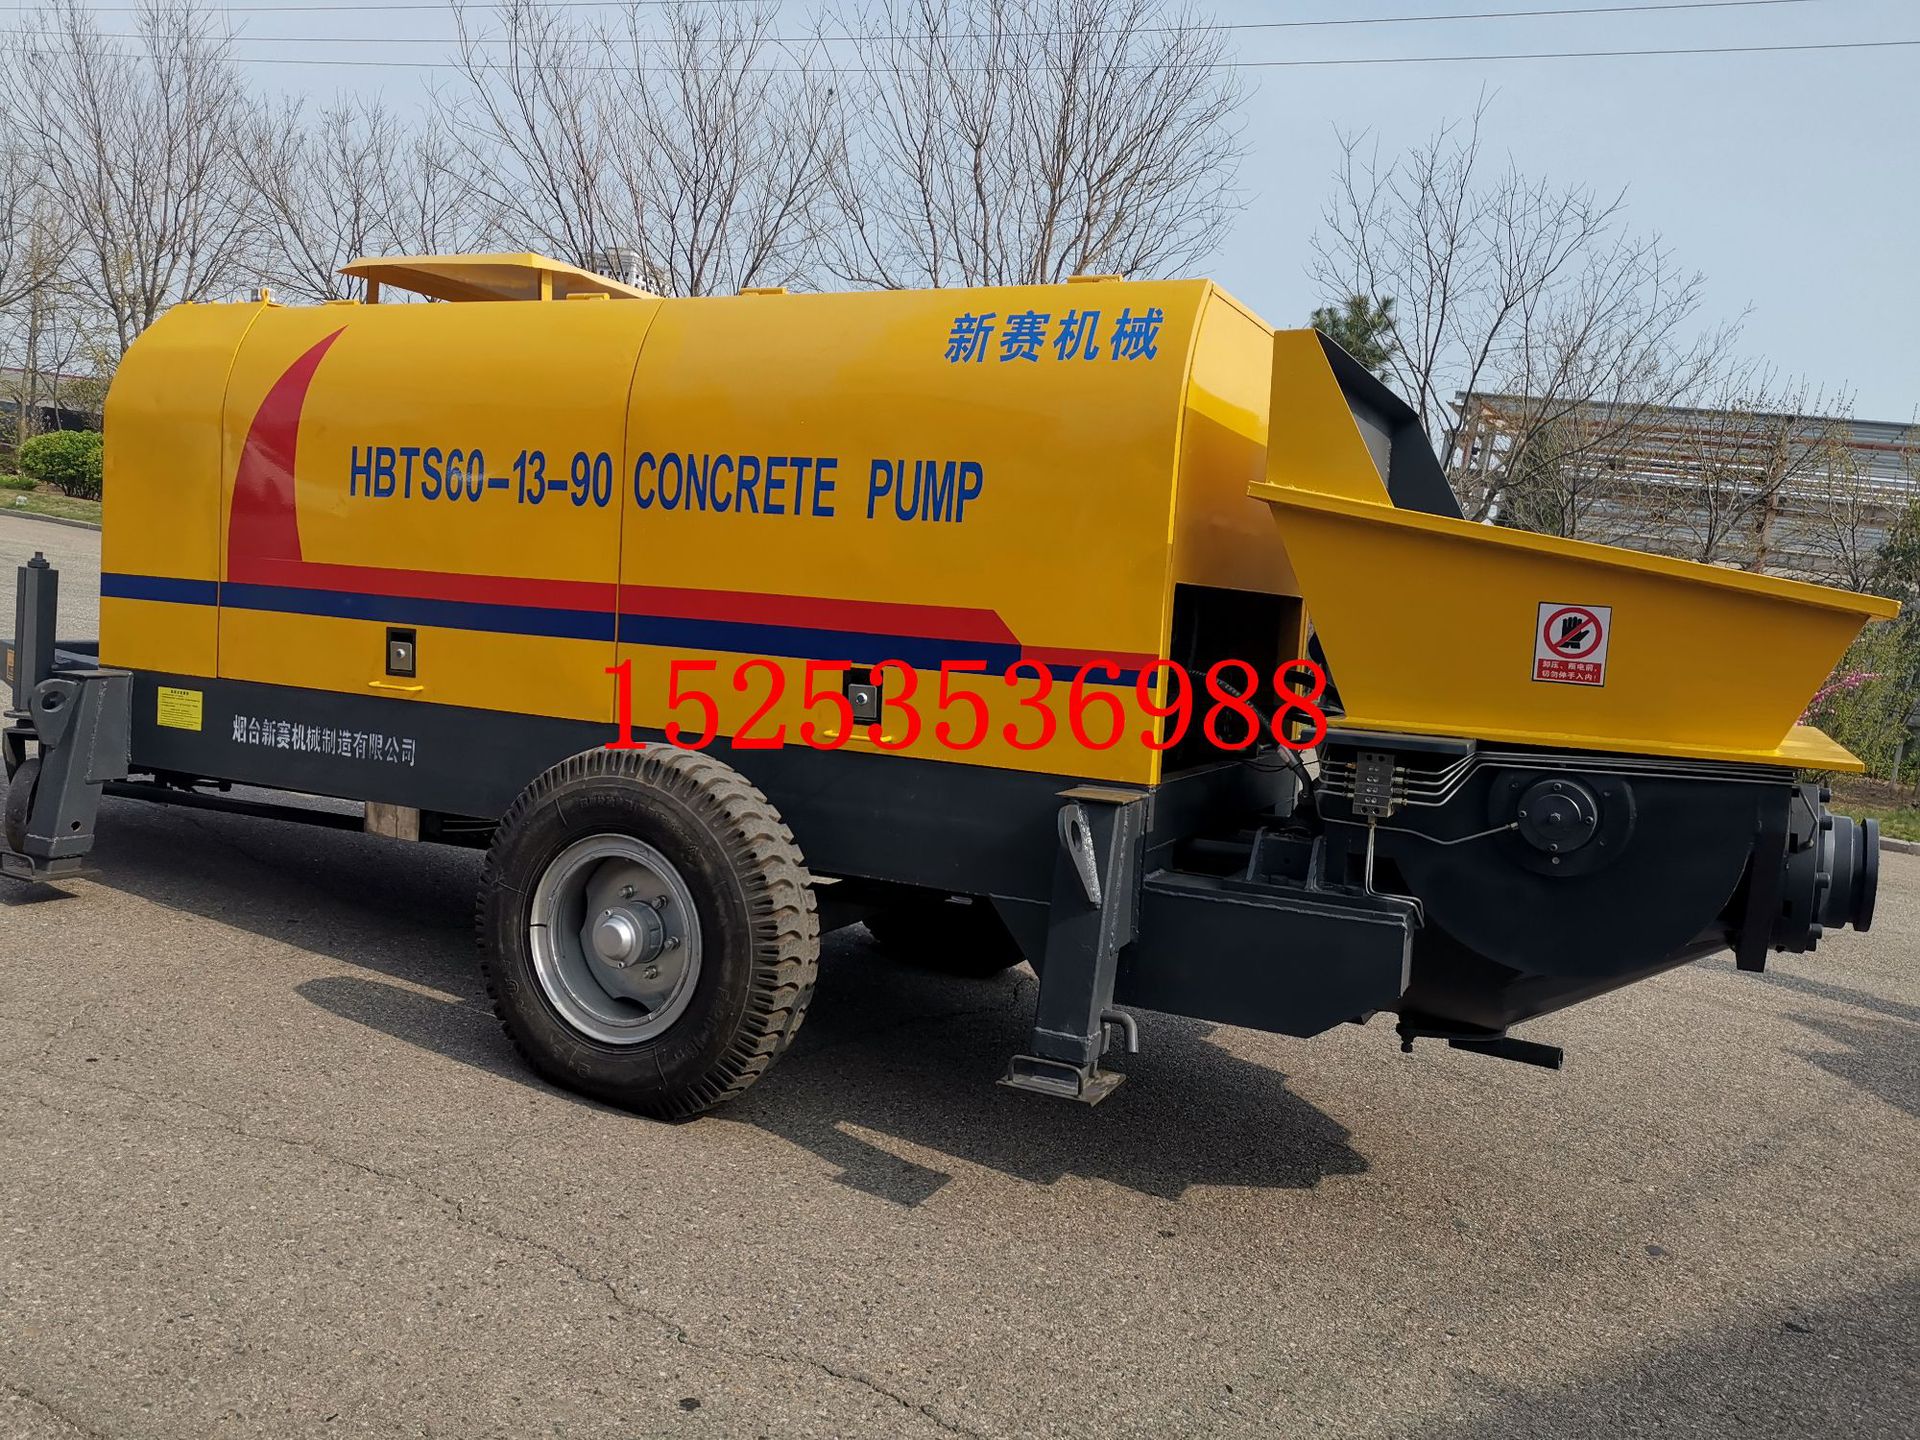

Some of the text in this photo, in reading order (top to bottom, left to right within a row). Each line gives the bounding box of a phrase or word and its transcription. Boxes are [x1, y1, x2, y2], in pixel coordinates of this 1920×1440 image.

[945, 307, 1164, 363] 新赛机械
[350, 446, 984, 523] HBTS60-13-90 CONCRETE PUMP
[232, 714, 416, 767] 烟台新赛机械制造有限公司
